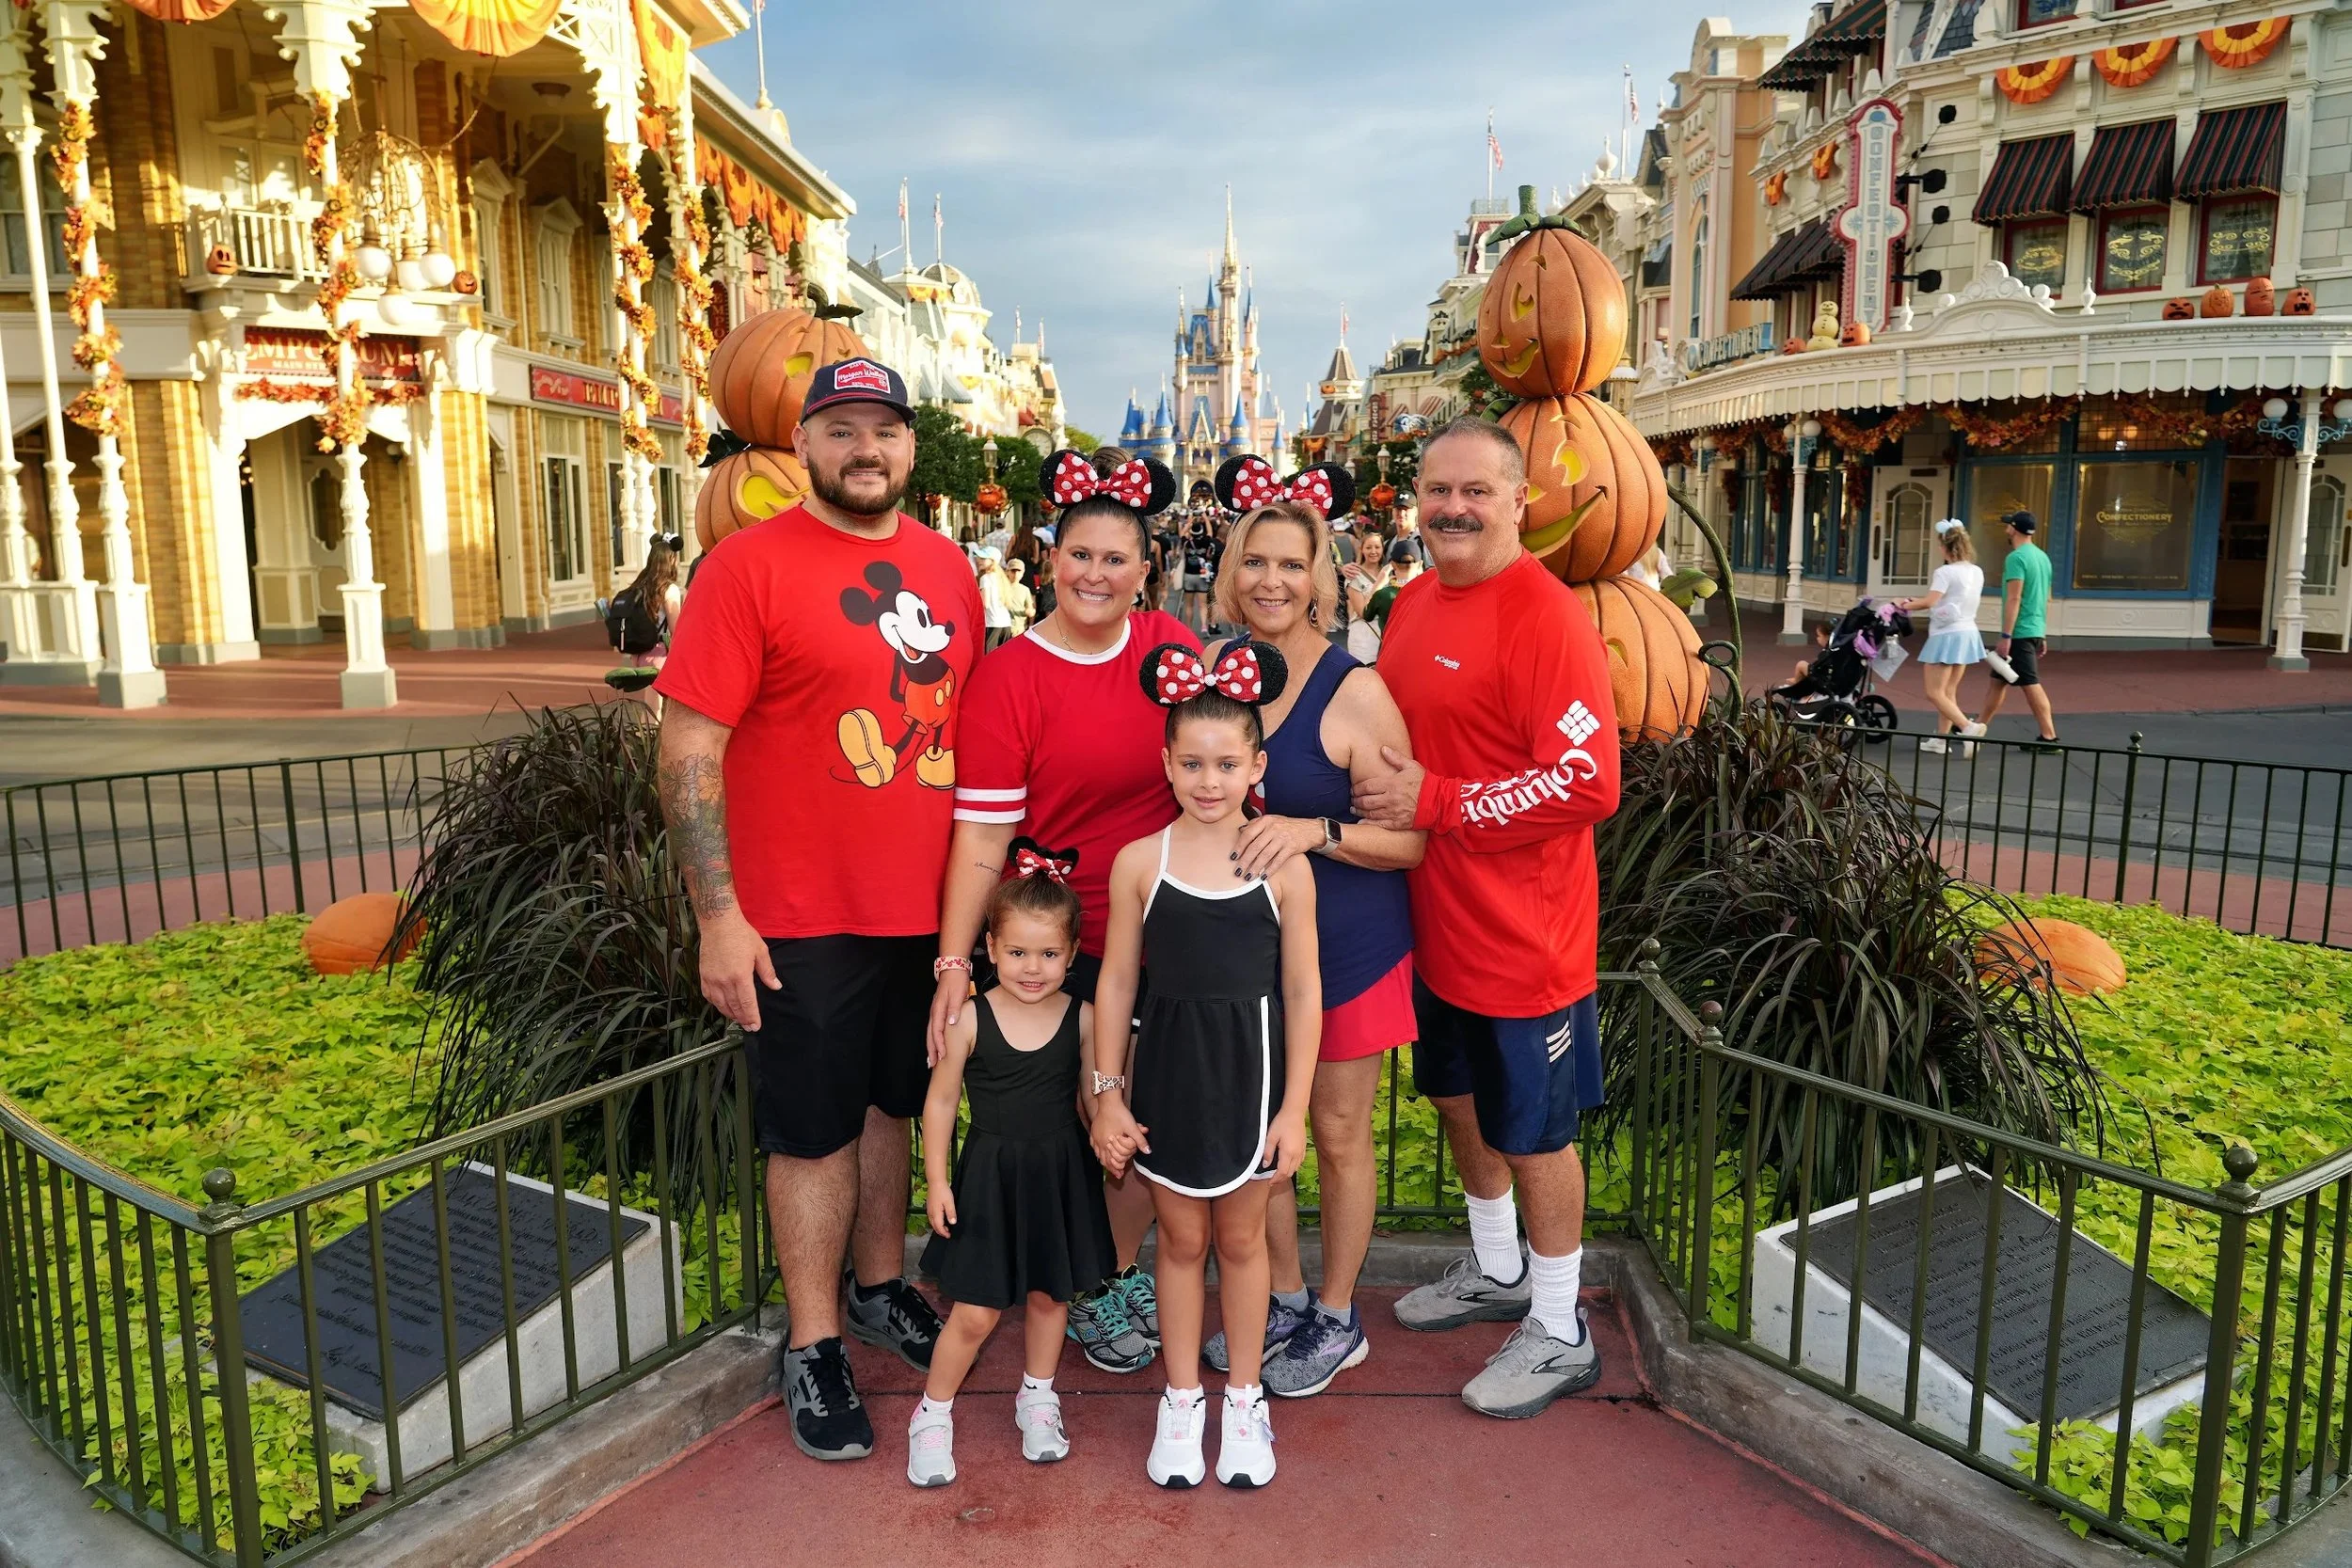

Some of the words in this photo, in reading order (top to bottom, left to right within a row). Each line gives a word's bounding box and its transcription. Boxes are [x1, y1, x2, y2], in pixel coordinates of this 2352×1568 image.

[1864, 126, 1883, 323] CONFECTIONERY
[245, 335, 405, 367] EMPOUM
[2096, 511, 2173, 523] CONFECTIONERY
